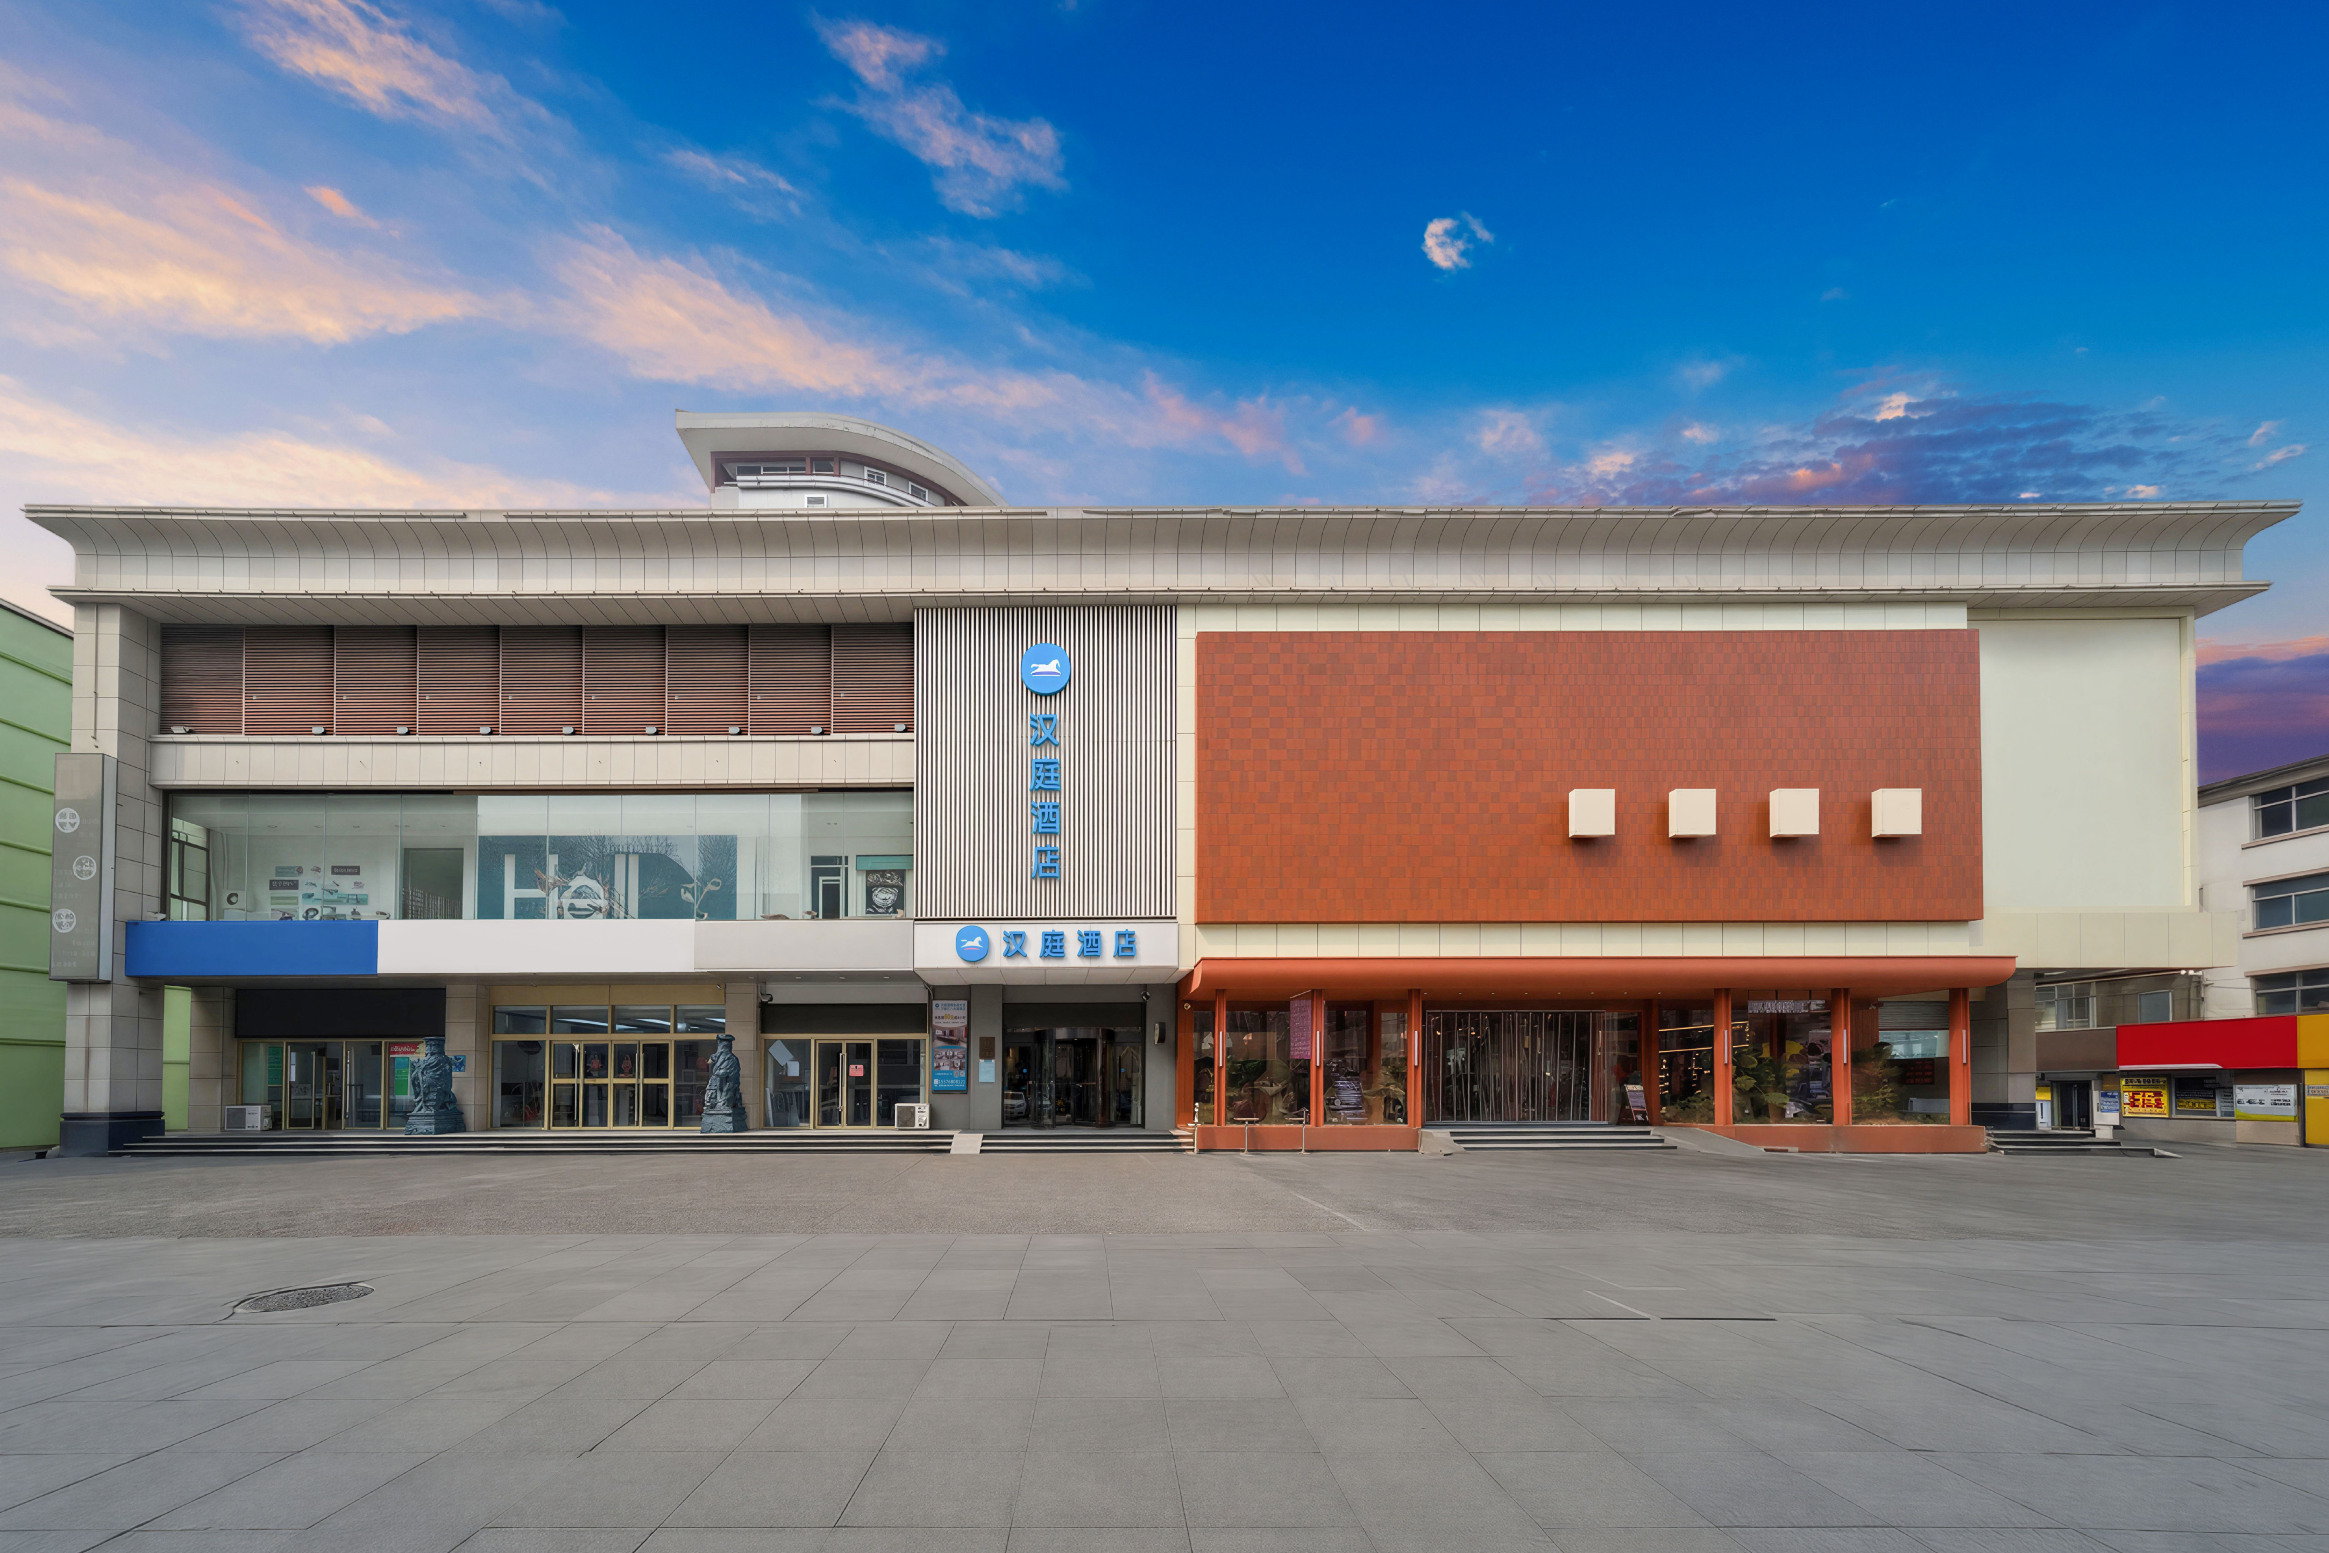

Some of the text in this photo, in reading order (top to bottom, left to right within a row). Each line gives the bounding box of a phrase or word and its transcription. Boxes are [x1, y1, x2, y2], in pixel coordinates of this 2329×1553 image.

[1030, 712, 1061, 880] 汉庭酒店
[1002, 929, 1137, 958] 汉庭酒店
